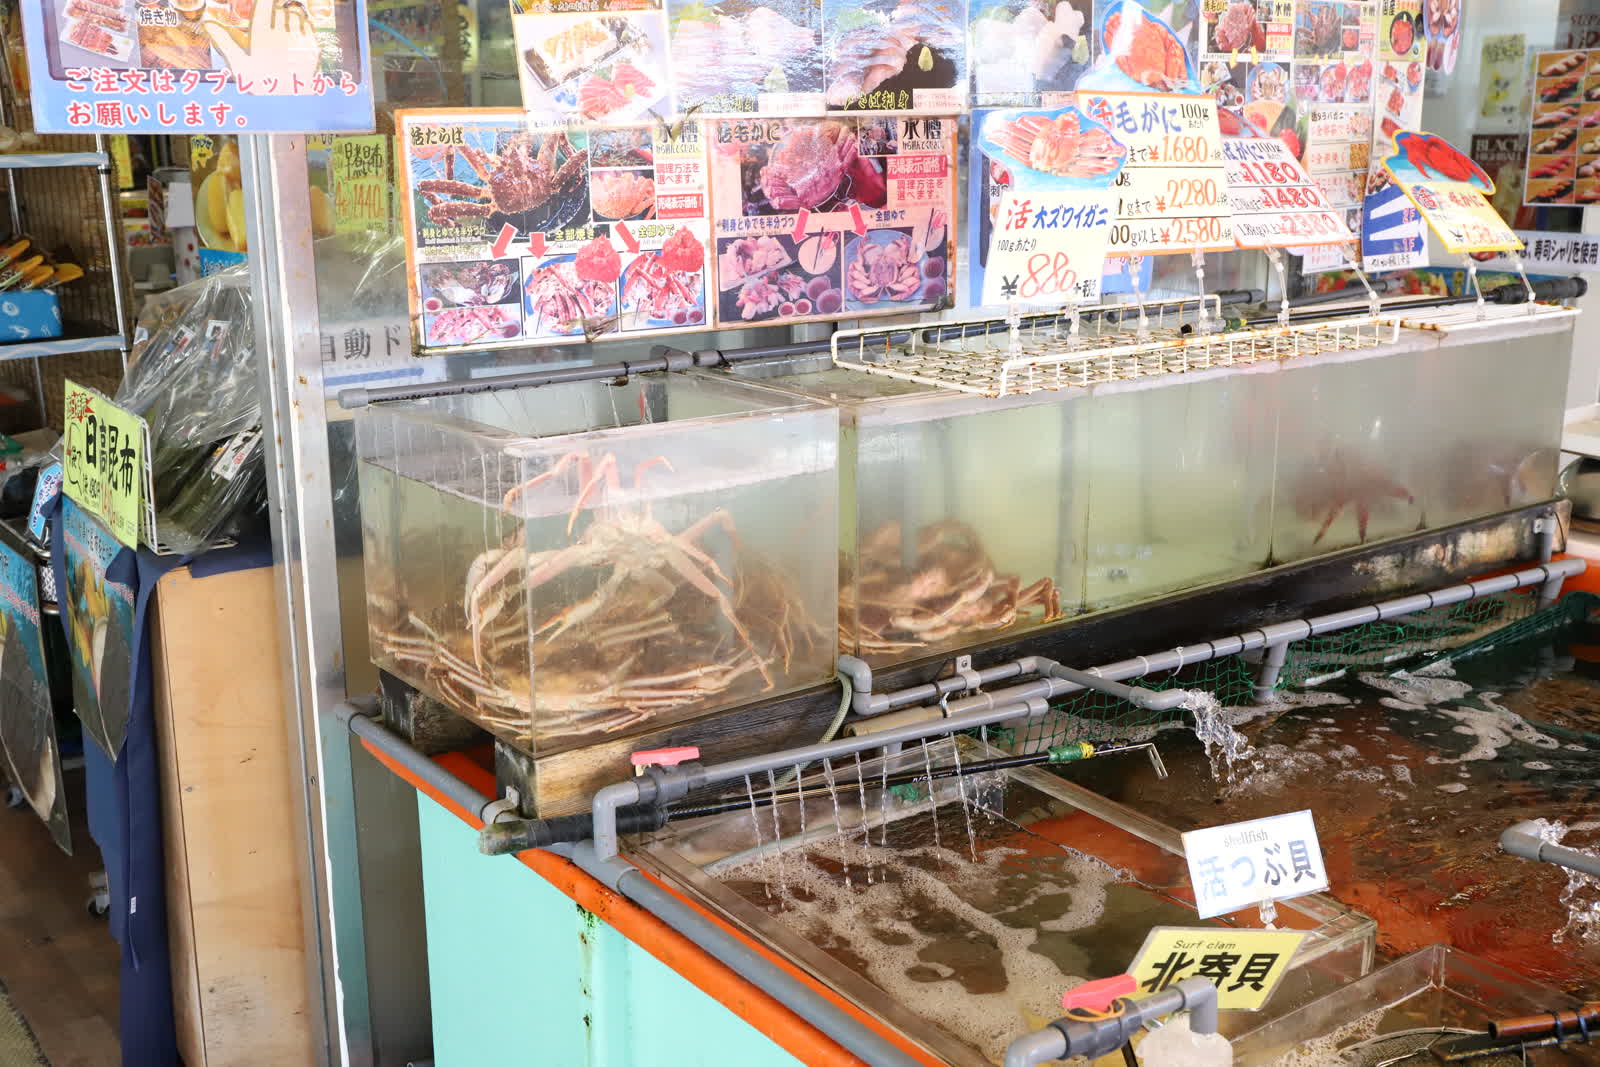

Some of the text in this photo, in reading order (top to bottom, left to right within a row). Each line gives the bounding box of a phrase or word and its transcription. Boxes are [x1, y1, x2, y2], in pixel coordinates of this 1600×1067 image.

[139, 8, 178, 26] 焼き物
[64, 69, 358, 96] ご注文はタブレットから
[67, 101, 250, 127] お願いします。
[1180, 103, 1209, 121] 100g
[410, 126, 464, 146] 活たらば
[901, 119, 942, 140] 水槽
[1476, 139, 1523, 151] BLACK
[86, 415, 136, 498] 日高昆布
[1223, 828, 1269, 848] shellfish
[1198, 839, 1316, 899] 活つぶ貝
[1173, 939, 1237, 950] Surf clam
